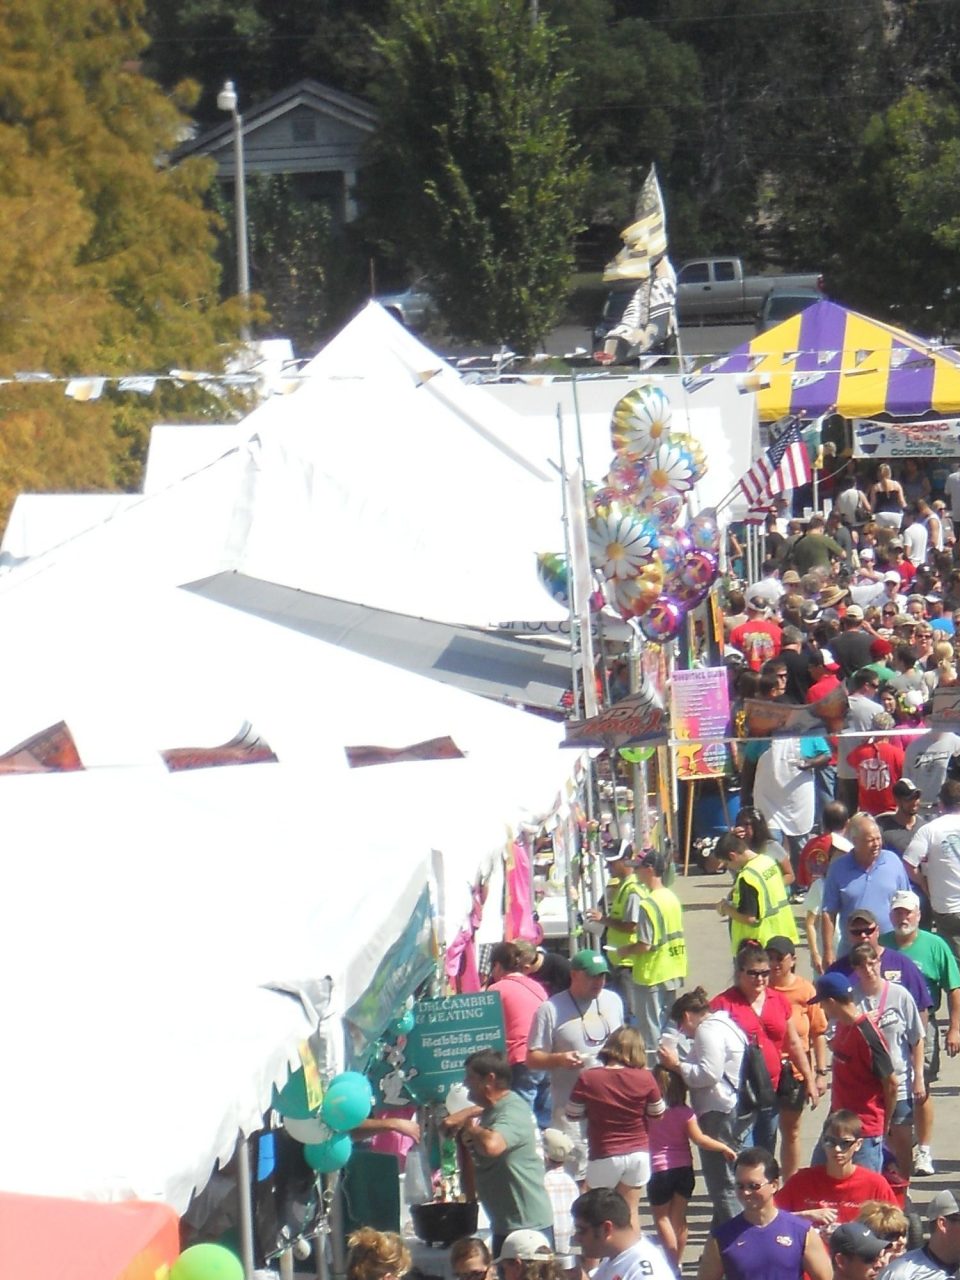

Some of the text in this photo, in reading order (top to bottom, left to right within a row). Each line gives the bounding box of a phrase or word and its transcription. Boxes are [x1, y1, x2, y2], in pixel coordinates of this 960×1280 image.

[422, 1029, 502, 1048] Rabbit and
[639, 1260, 654, 1276] 9
